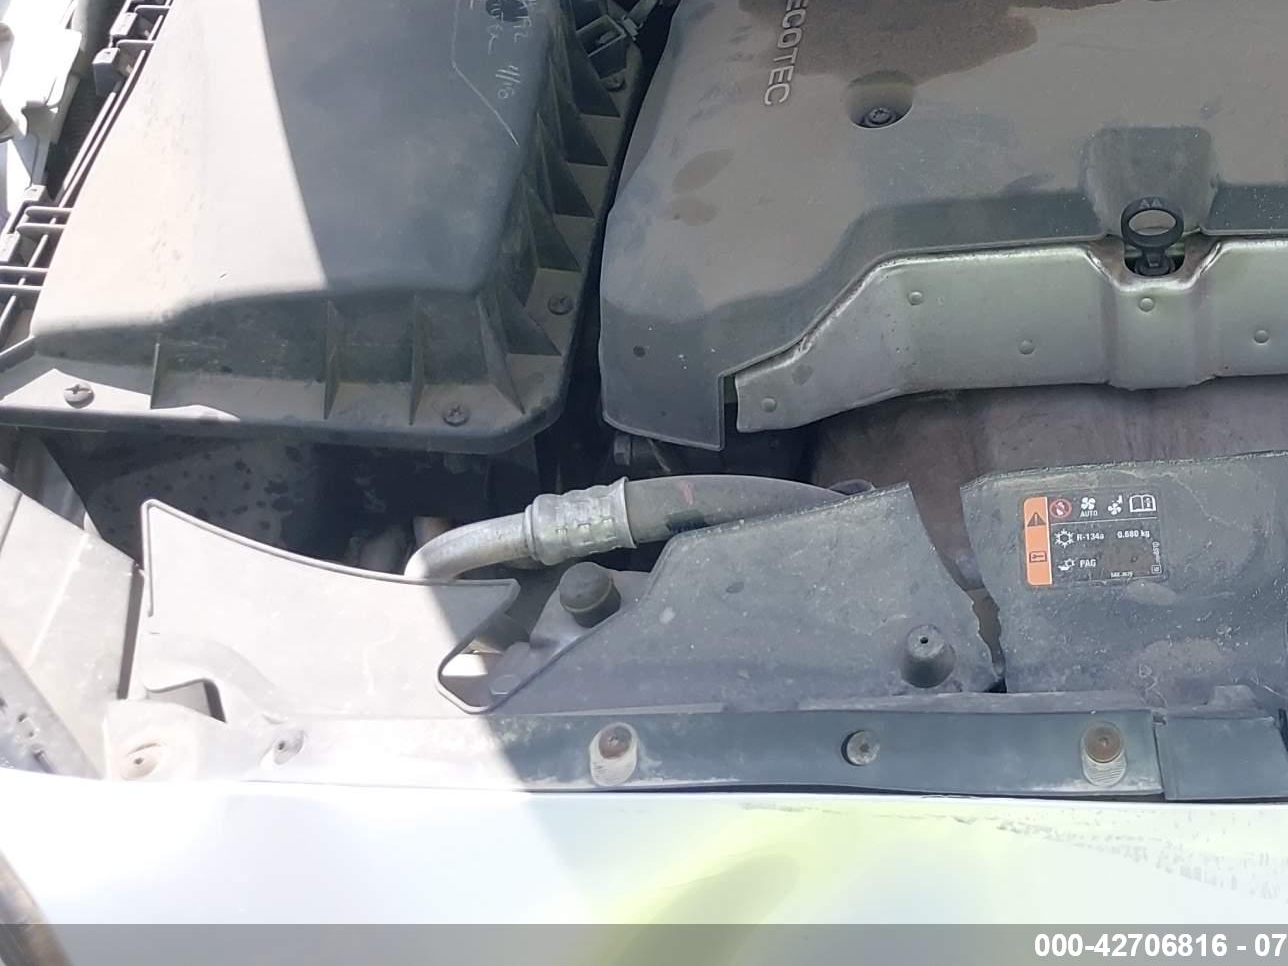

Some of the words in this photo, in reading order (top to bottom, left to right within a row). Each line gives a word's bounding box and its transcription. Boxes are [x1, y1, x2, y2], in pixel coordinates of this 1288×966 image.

[1076, 533, 1105, 541] R-134a
[1141, 529, 1150, 538] kg
[1080, 559, 1096, 568] PAG
